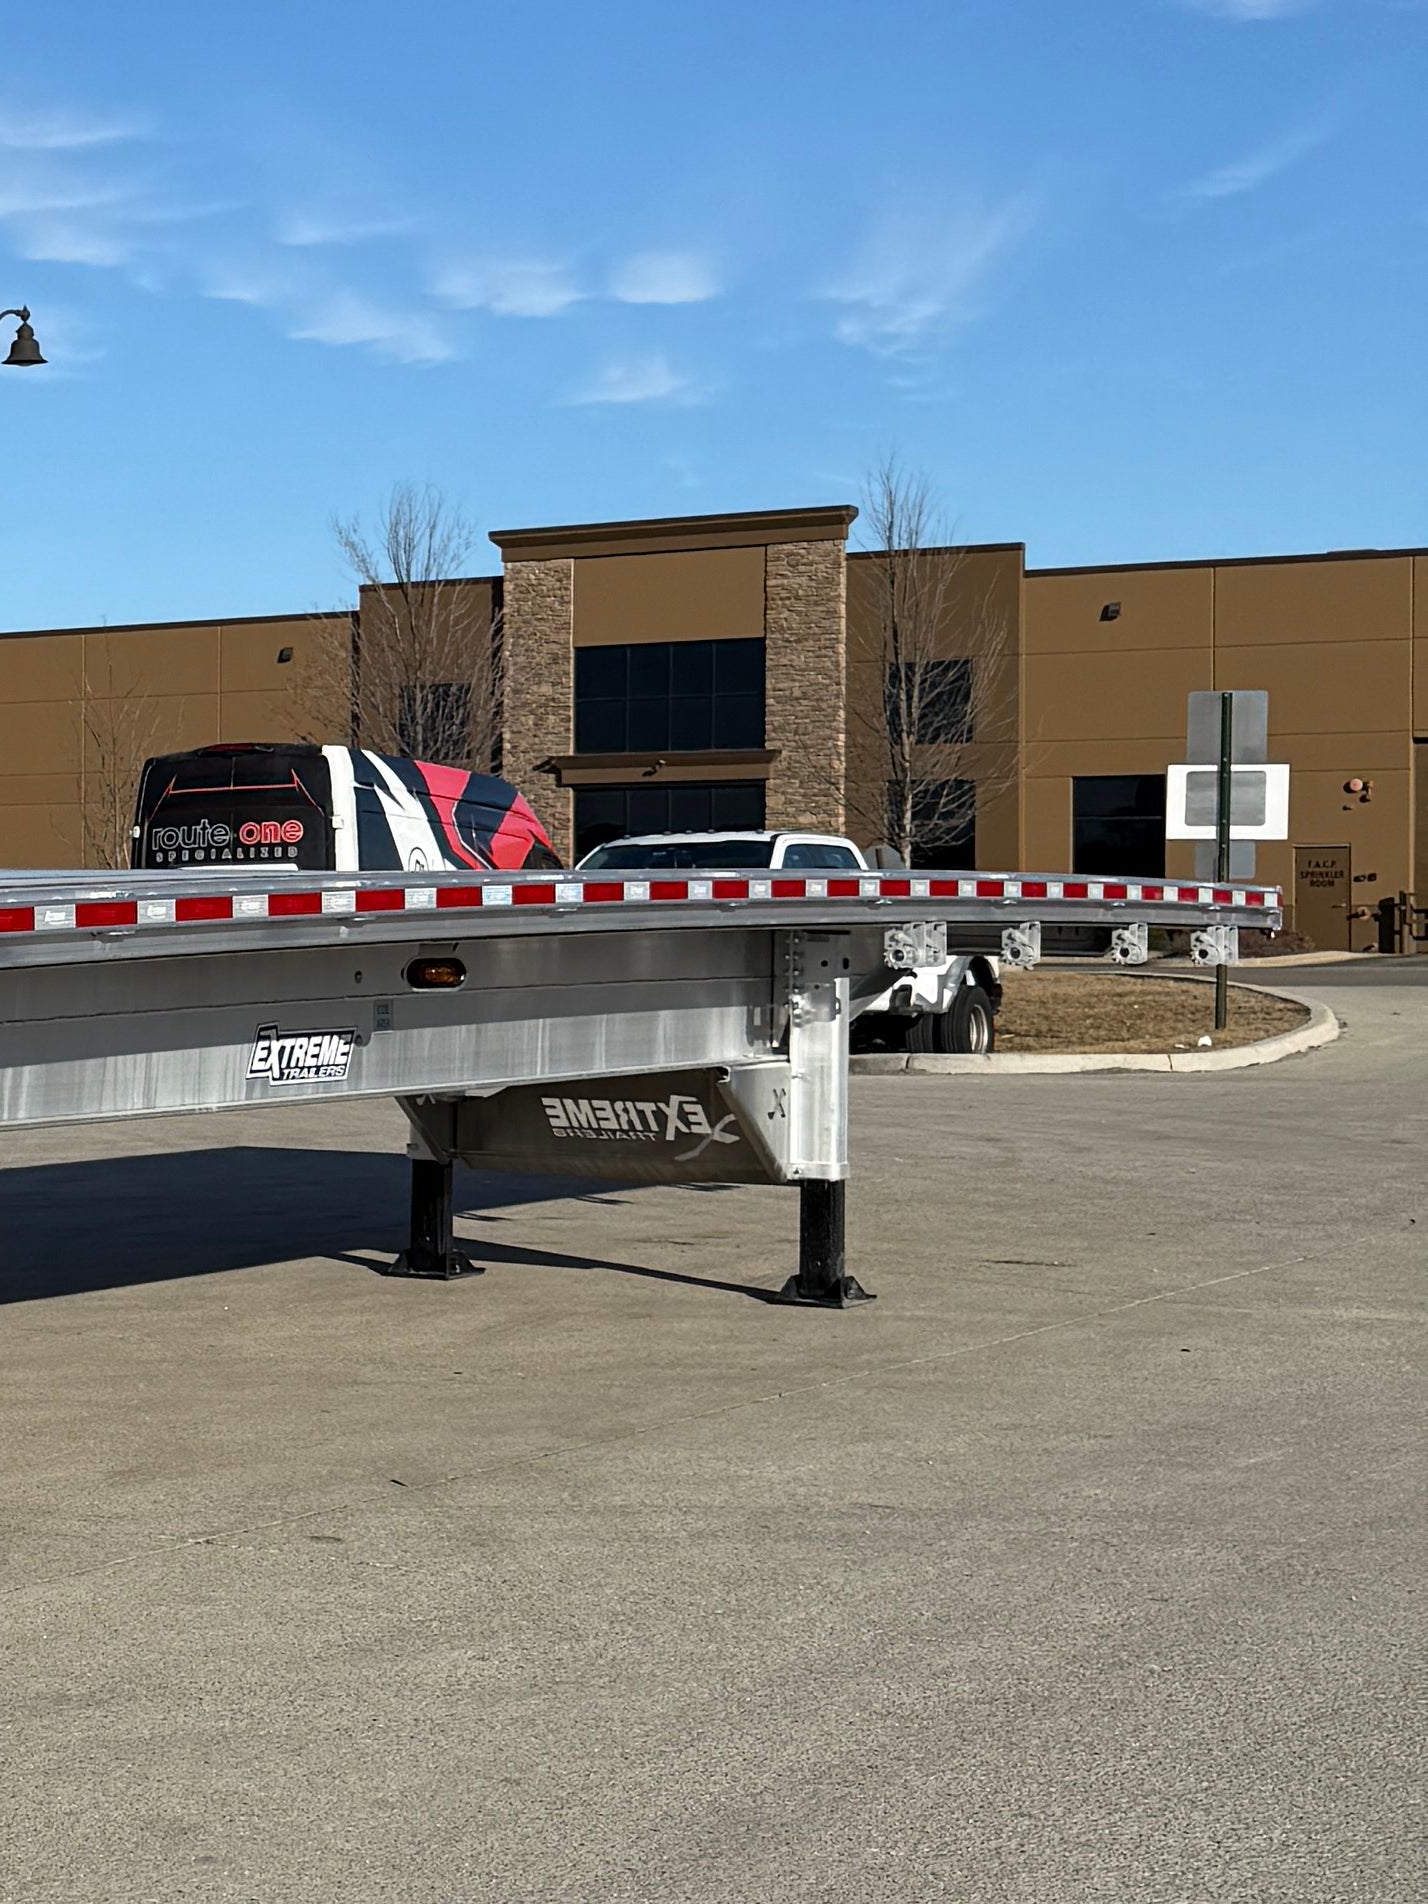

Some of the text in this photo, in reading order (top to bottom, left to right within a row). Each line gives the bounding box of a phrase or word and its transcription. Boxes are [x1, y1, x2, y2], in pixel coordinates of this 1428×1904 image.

[152, 818, 304, 850] route one
[156, 846, 298, 863] SPECIALIZED
[1300, 869, 1344, 879] SPRINKLER
[1309, 879, 1335, 888] ROOM
[252, 1029, 353, 1079] EXTREME
[281, 1065, 345, 1080] TRAILERS
